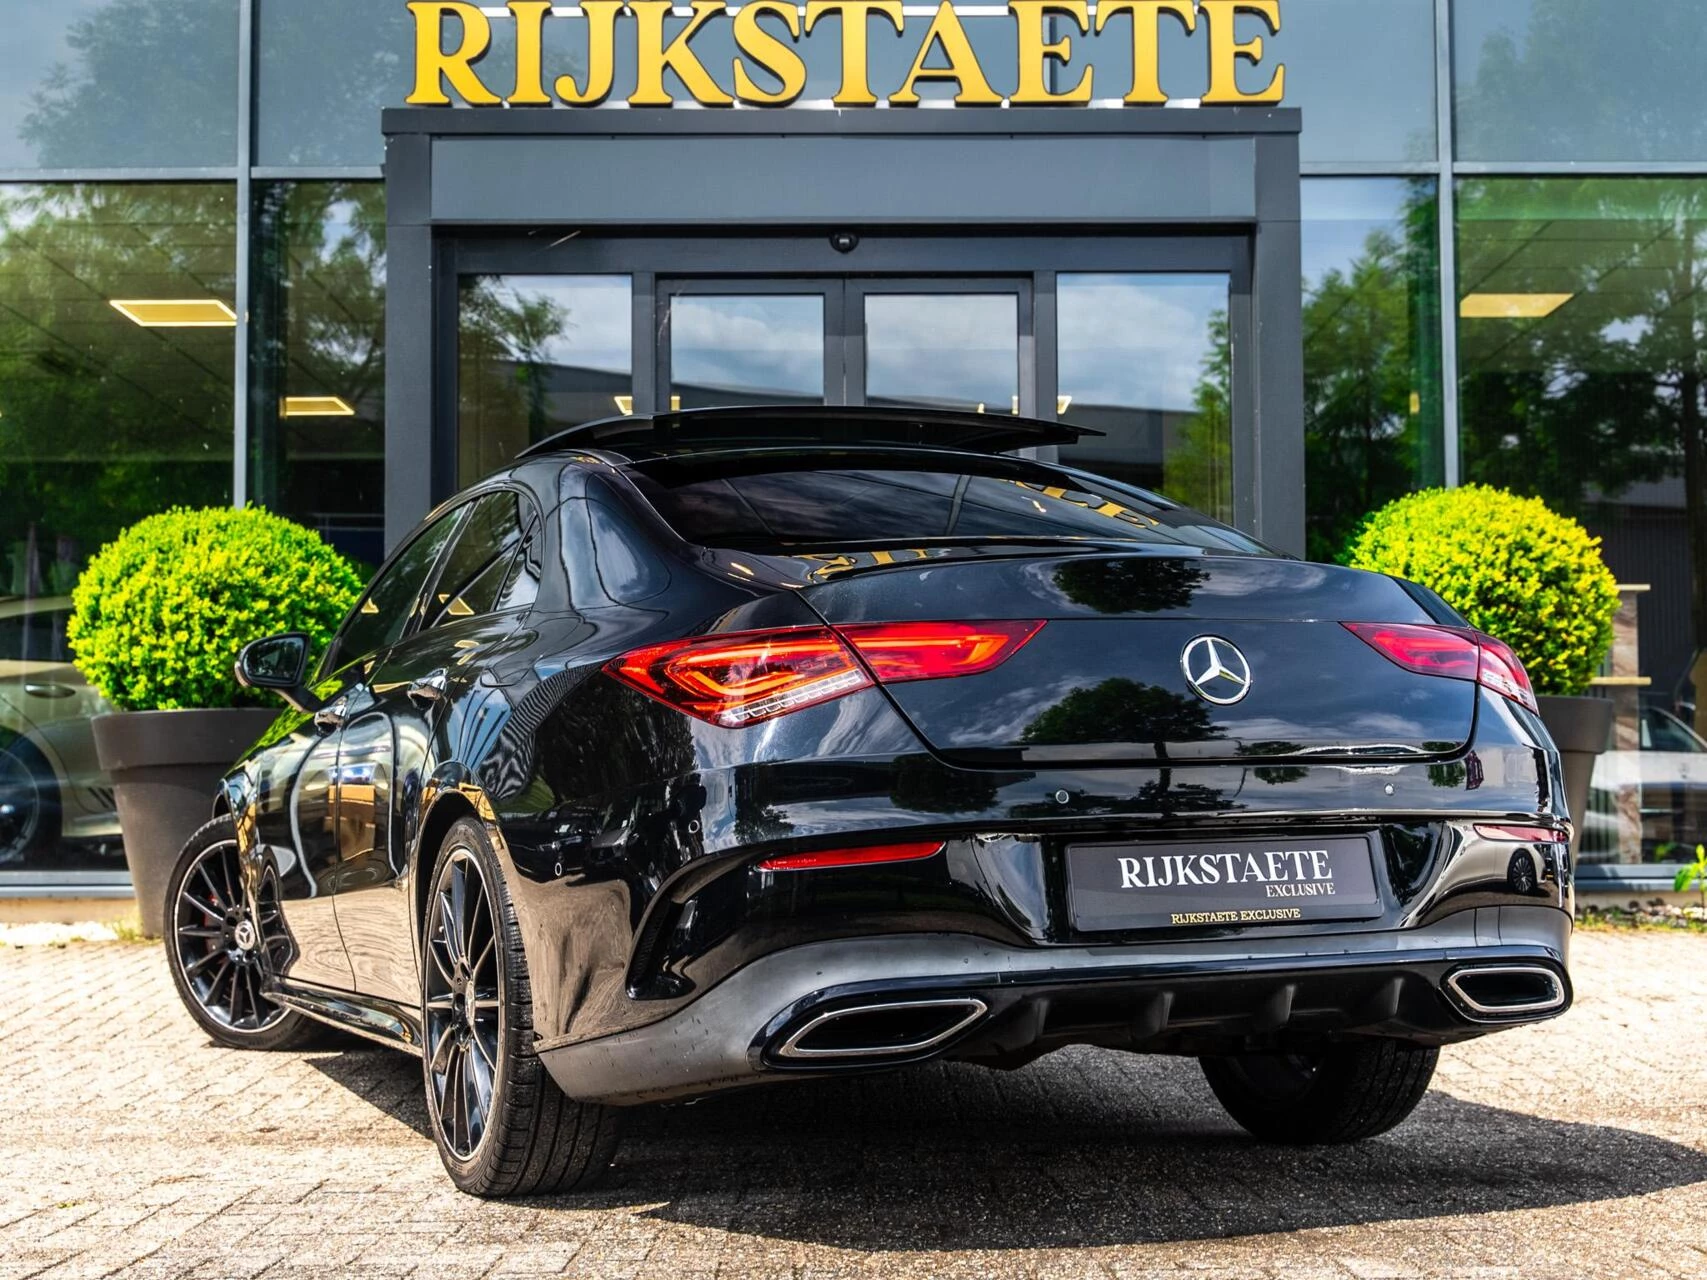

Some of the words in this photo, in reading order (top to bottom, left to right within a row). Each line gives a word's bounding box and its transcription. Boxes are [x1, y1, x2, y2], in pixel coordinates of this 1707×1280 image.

[405, 0, 1285, 106] RIJKSTAETE
[1118, 850, 1332, 888] RIJKSTAETE
[1266, 882, 1335, 897] EXCLUSIVE
[1171, 911, 1238, 924] RIJKSTAETE
[1241, 908, 1301, 920] EXCLUSIVE
